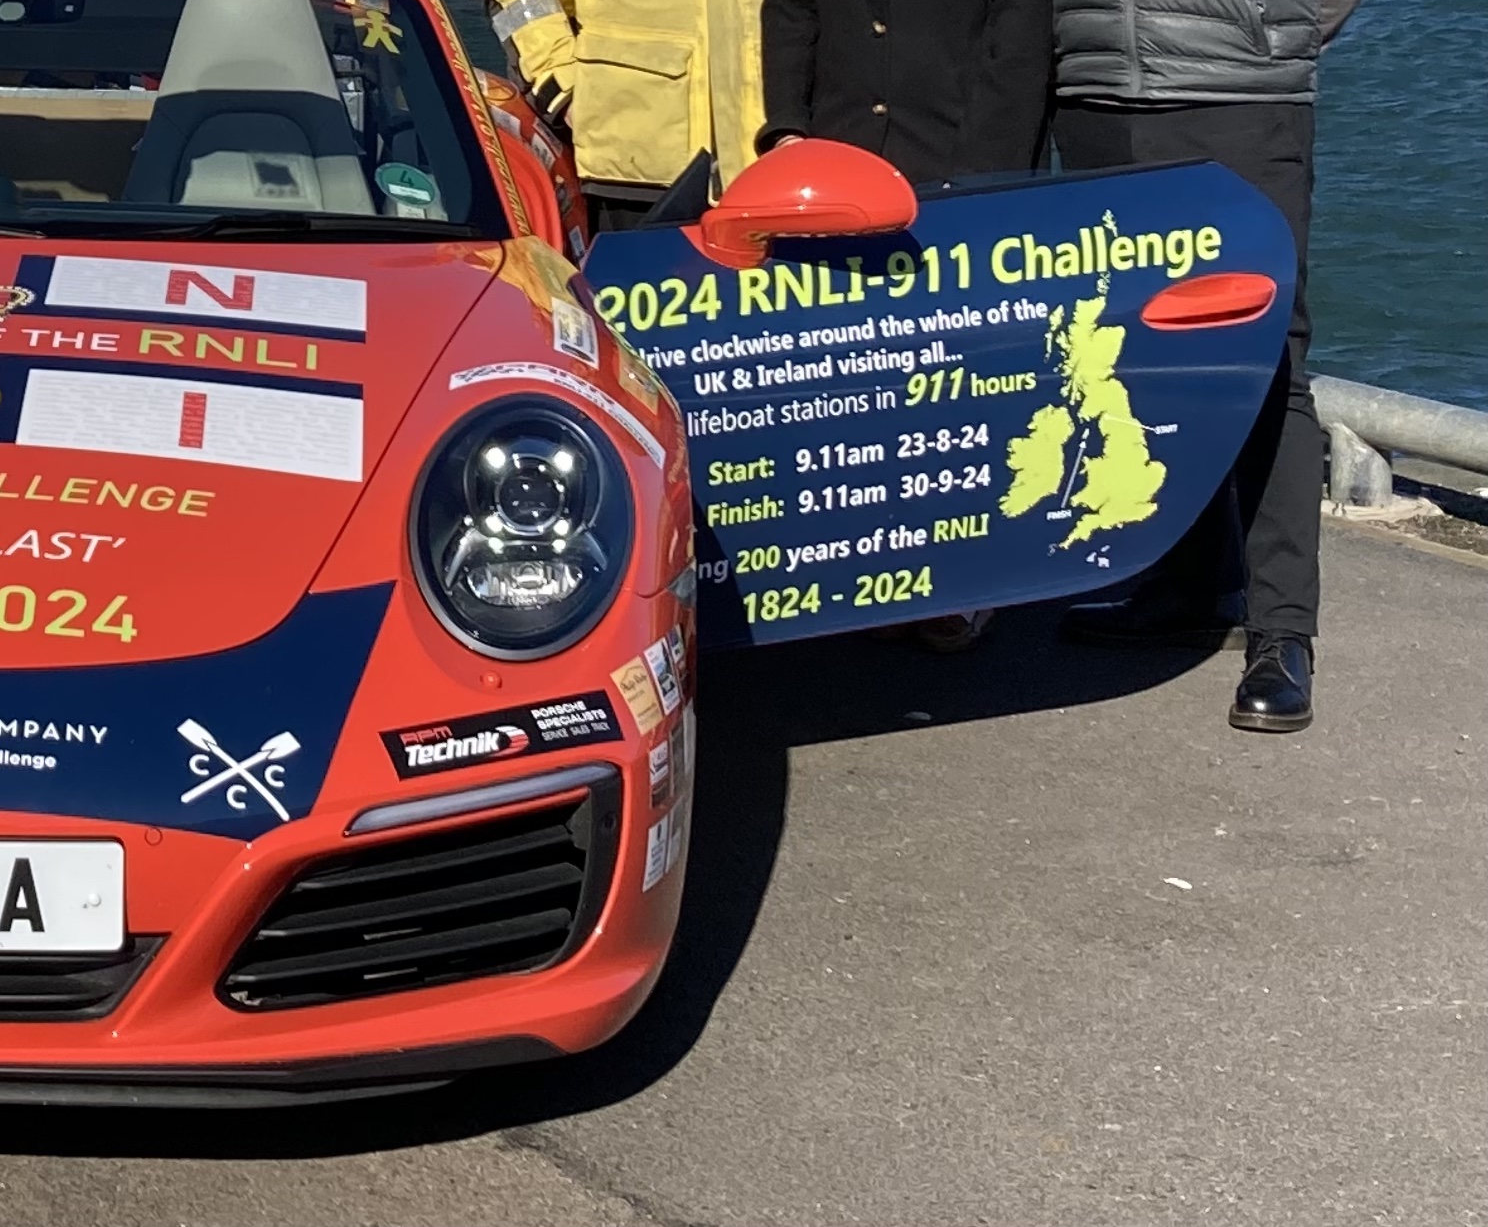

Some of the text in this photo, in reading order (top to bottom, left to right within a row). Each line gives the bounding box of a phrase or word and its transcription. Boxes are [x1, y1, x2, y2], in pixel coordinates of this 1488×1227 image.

[400, 170, 414, 186] 4
[165, 269, 255, 311] N
[594, 226, 1222, 333] 2024 RNLI-911 Challenge
[21, 328, 121, 352] THE
[138, 328, 318, 370] RNLI
[691, 331, 793, 363] clockwise
[798, 317, 875, 348] around
[879, 313, 915, 338] the
[919, 306, 982, 334] whole
[987, 303, 1010, 325] of
[1012, 297, 1048, 322] the
[694, 341, 963, 396] UK & Ireland visiting all...
[178, 391, 207, 449] I
[687, 367, 1036, 437] lifeboat stations in 911 hours
[708, 423, 989, 486] Start: 9.11am 23-8-24
[707, 464, 991, 527] Finish: 9.11am 30-9-24
[735, 545, 781, 573] 200
[785, 539, 850, 573] years
[856, 528, 883, 555] of
[888, 525, 927, 551] the
[933, 513, 990, 543] RNLI
[743, 583, 821, 623] 1824
[854, 566, 932, 607] 2024
[531, 700, 587, 719] PORSCHE
[536, 708, 607, 730] SPECIALISTS
[399, 725, 453, 746] RPM
[405, 731, 500, 766] Technik
[189, 754, 286, 788] C C
[226, 784, 248, 809] C
